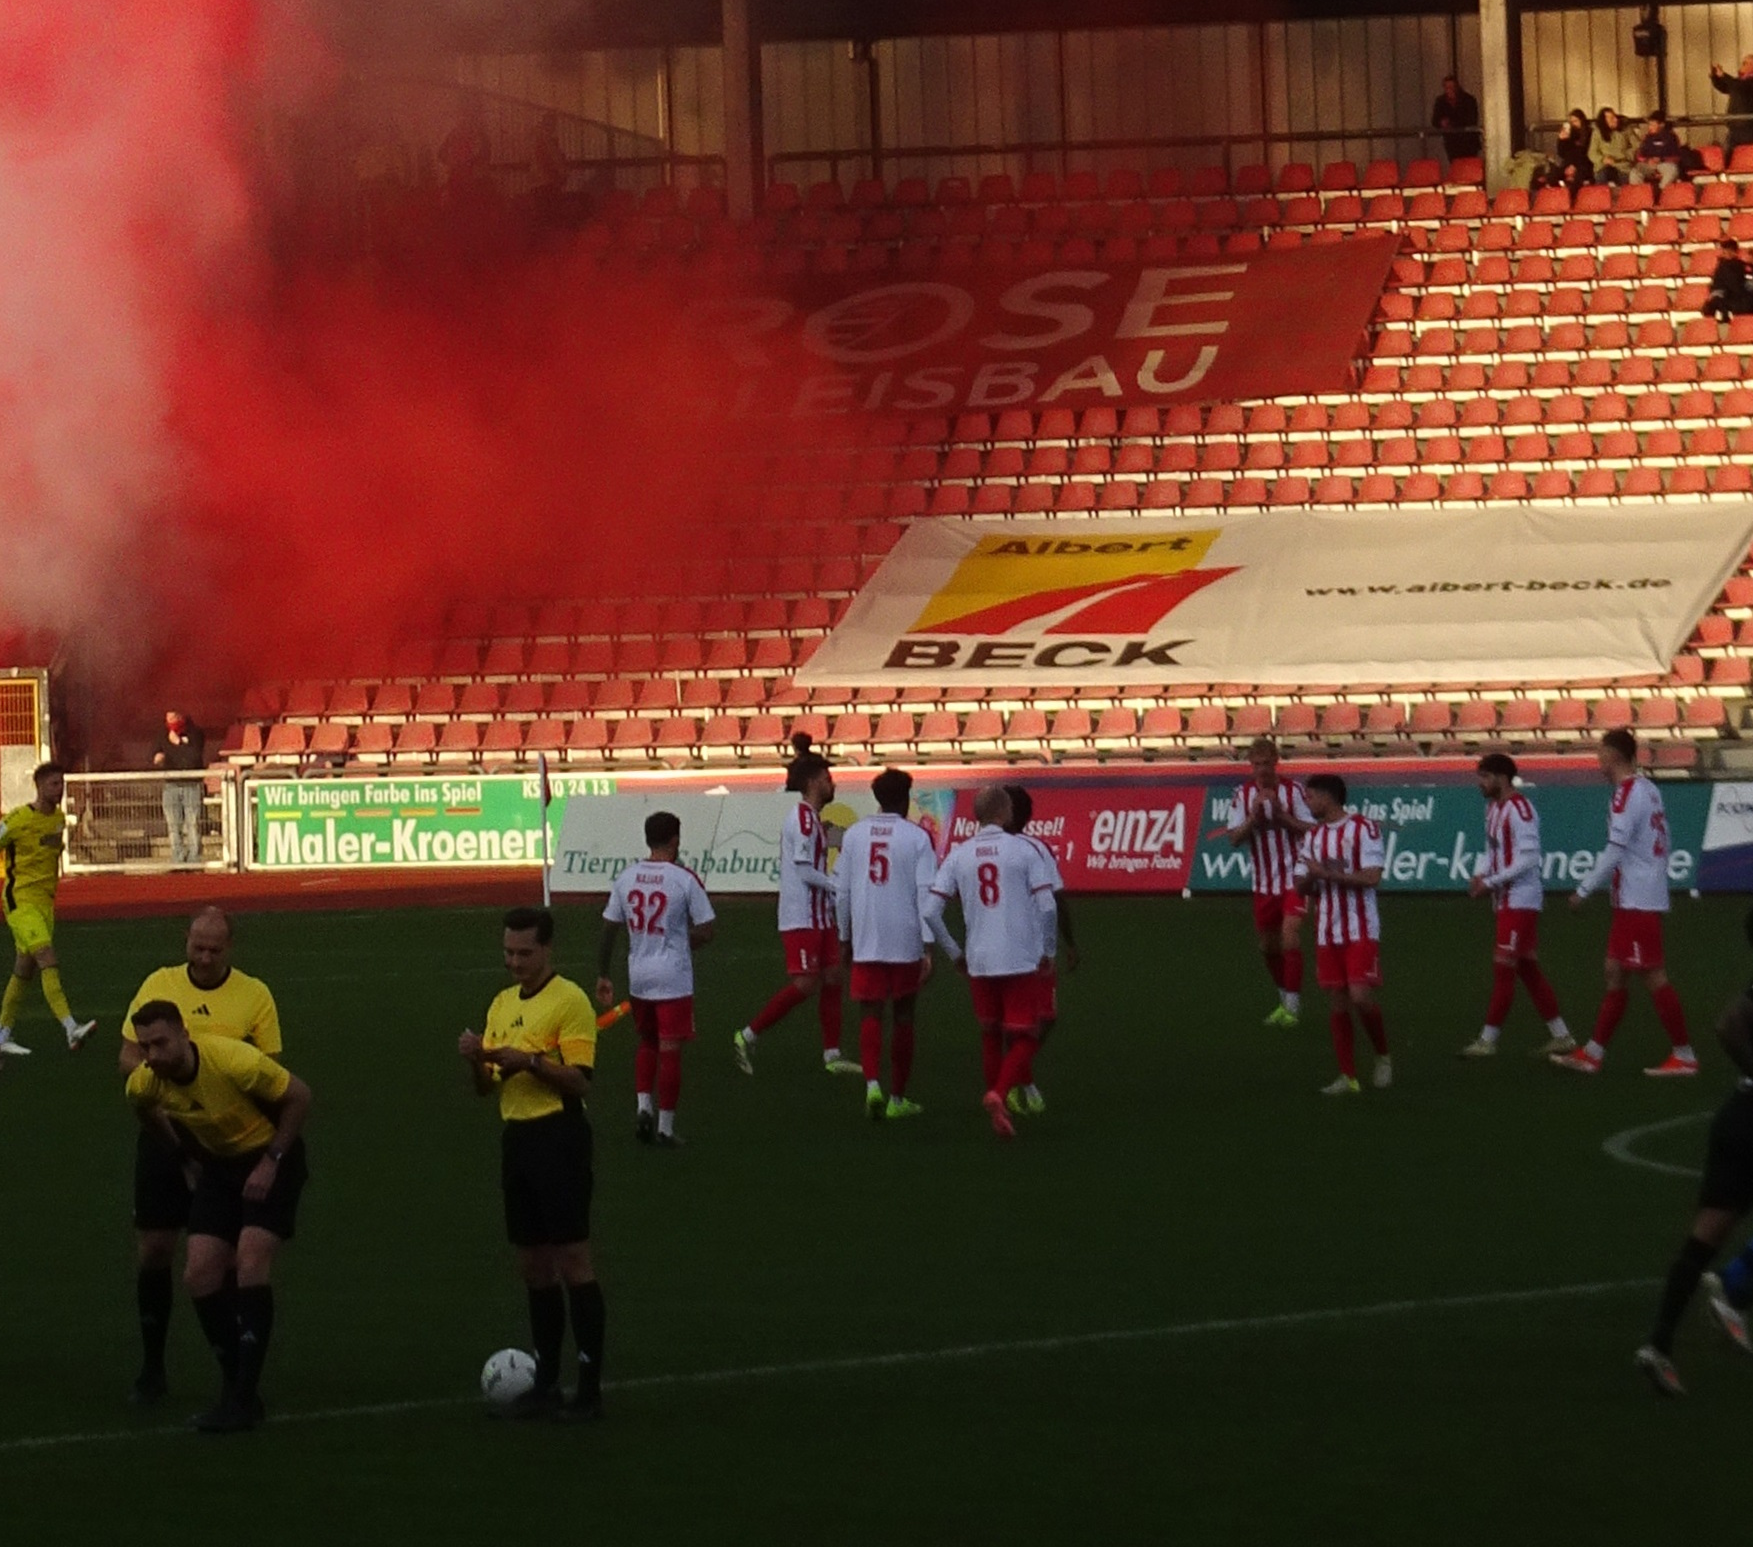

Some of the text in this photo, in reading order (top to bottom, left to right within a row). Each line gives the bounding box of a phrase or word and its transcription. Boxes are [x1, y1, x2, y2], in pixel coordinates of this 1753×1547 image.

[732, 344, 1220, 419] LEISBAU
[989, 537, 1193, 555] Albert
[1305, 577, 1672, 596] www.albert-beck.de
[882, 639, 1197, 669] BECK
[264, 781, 482, 809] Wir bringen Farbe ins Spiel
[568, 779, 587, 796] 24
[592, 779, 610, 796] 13
[1362, 798, 1386, 820] ins
[1390, 795, 1434, 825] Spiel
[266, 817, 553, 865] Maler-Kroenert
[1092, 802, 1185, 854] einzA
[563, 849, 645, 882] Tierp
[868, 841, 889, 886] 5
[1087, 855, 1182, 873] Wir bringen Farbe
[977, 862, 999, 907] 8
[627, 889, 667, 935] 32
